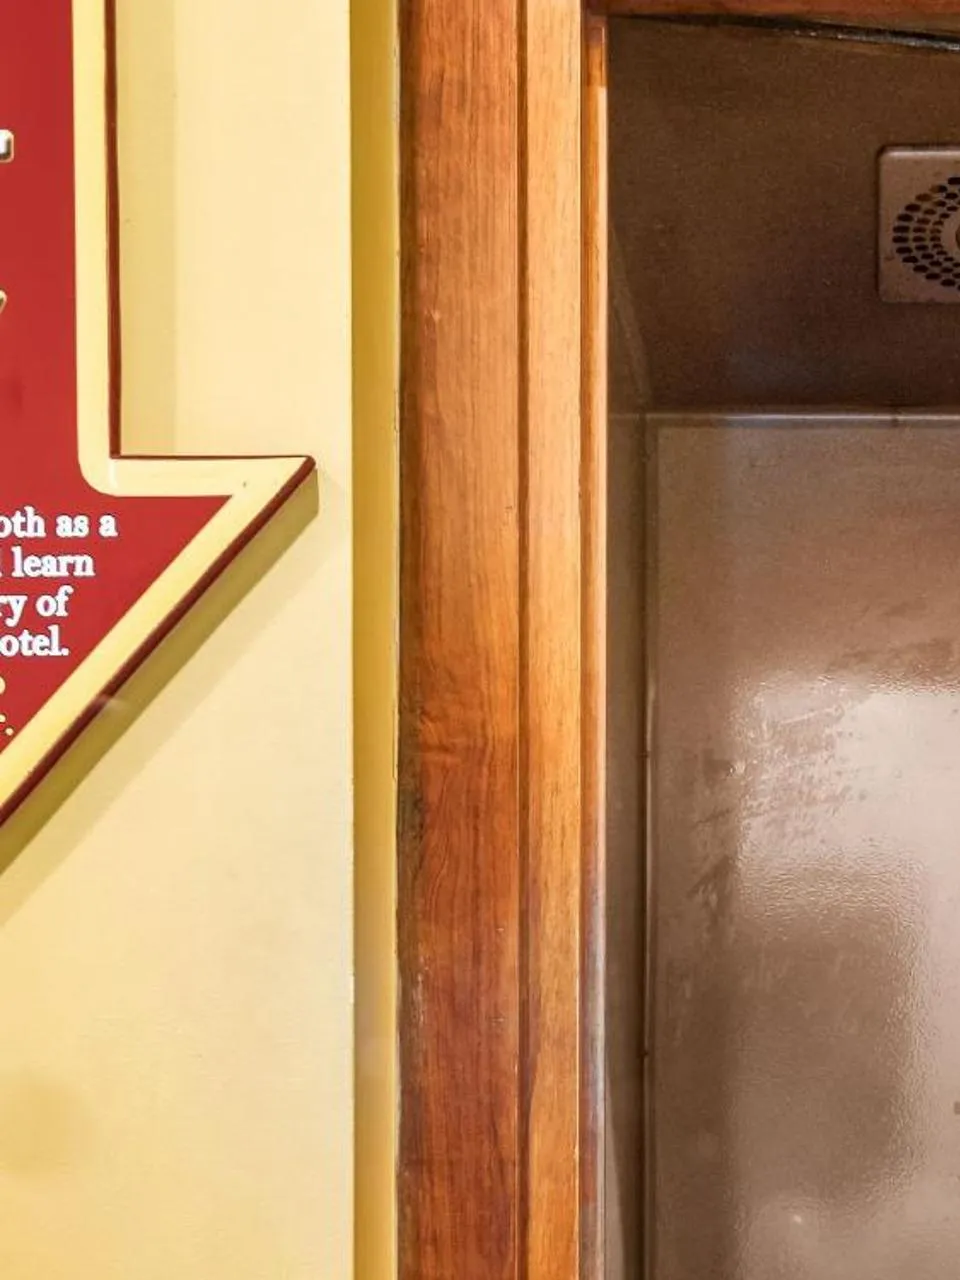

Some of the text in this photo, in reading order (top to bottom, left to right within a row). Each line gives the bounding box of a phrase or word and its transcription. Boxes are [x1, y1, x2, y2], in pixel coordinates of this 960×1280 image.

[56, 514, 90, 537] as
[99, 514, 119, 537] a
[11, 545, 96, 577] learn
[36, 584, 74, 617] of
[0, 624, 70, 657] otel.
